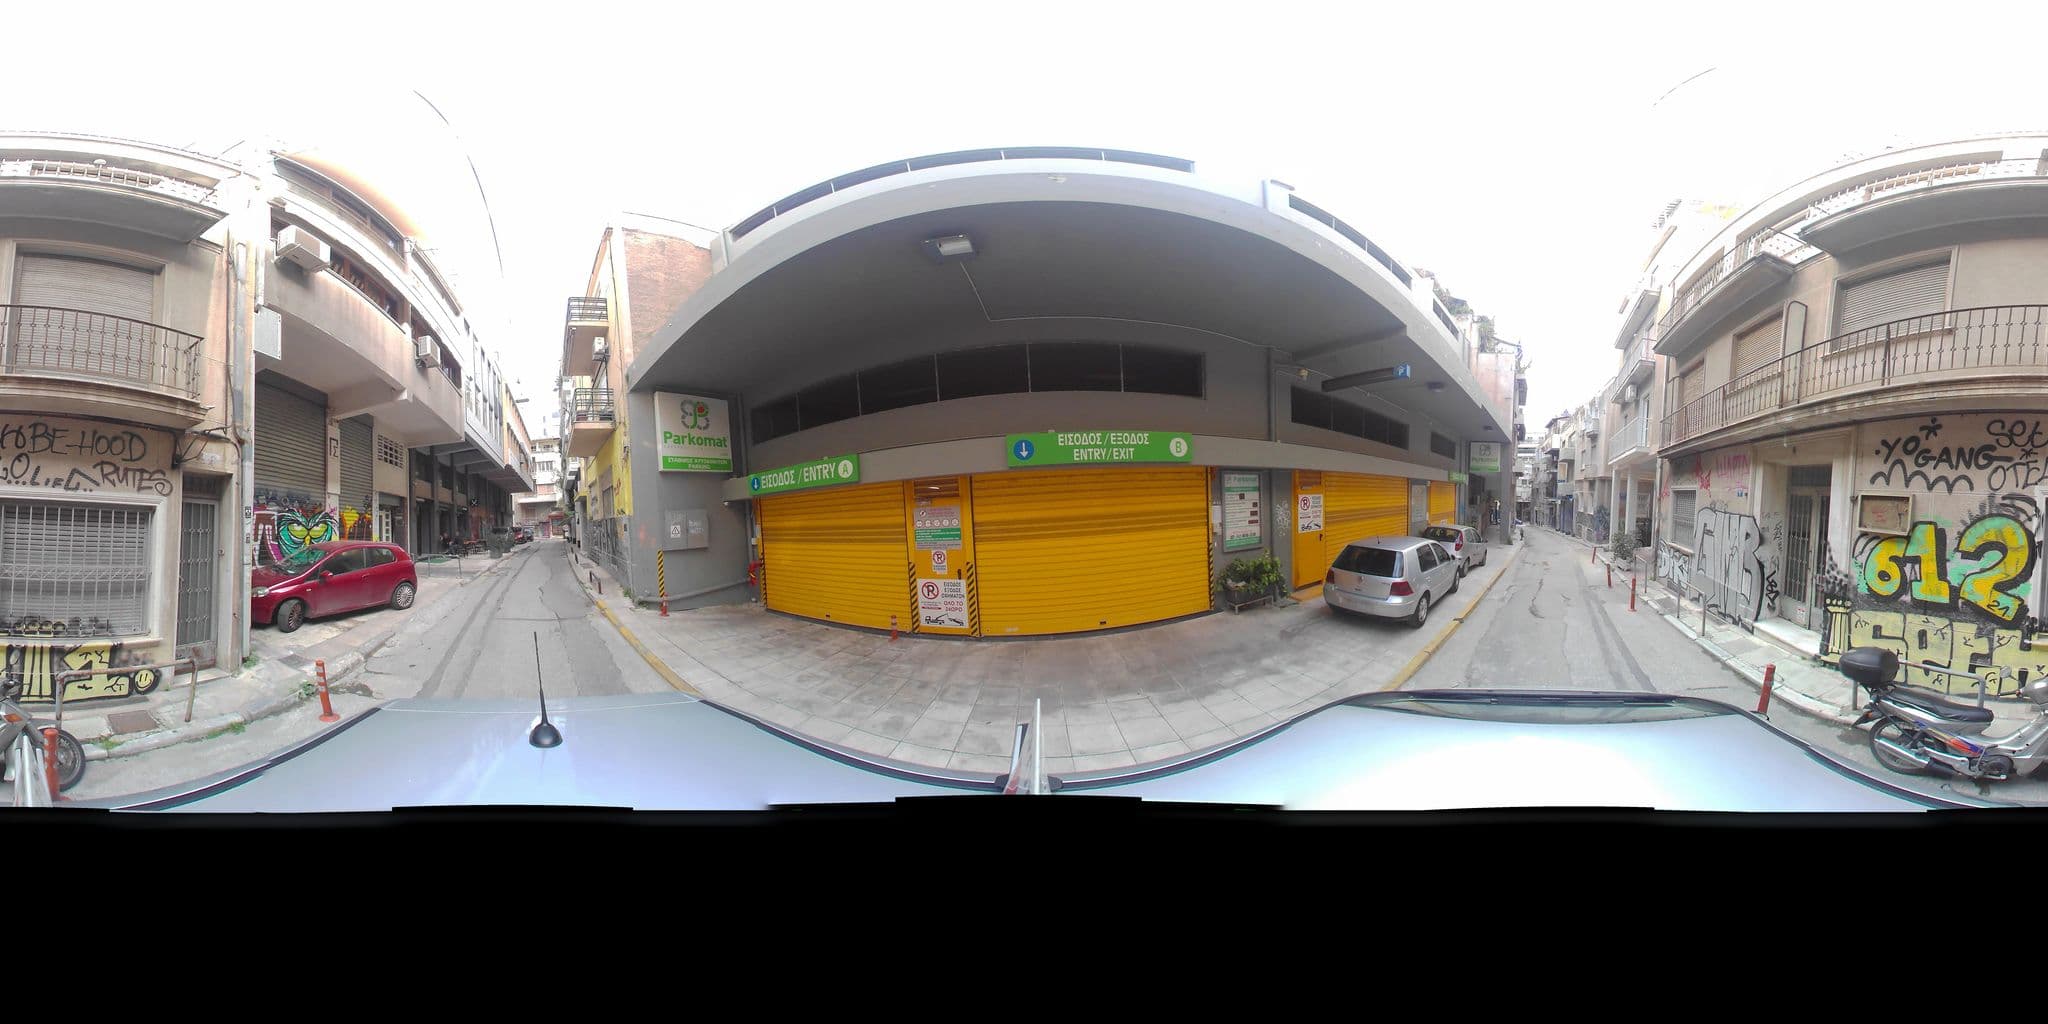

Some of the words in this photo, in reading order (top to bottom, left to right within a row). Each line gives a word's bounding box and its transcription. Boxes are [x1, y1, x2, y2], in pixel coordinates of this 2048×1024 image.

[663, 431, 728, 448] Parkomat
[1058, 433, 1102, 446] ΕΙΣΟΔΟΣ
[1914, 444, 2014, 470] GANG
[761, 470, 795, 489] ΕΙΣΟΔΟΣ
[1864, 513, 2036, 621] 612
